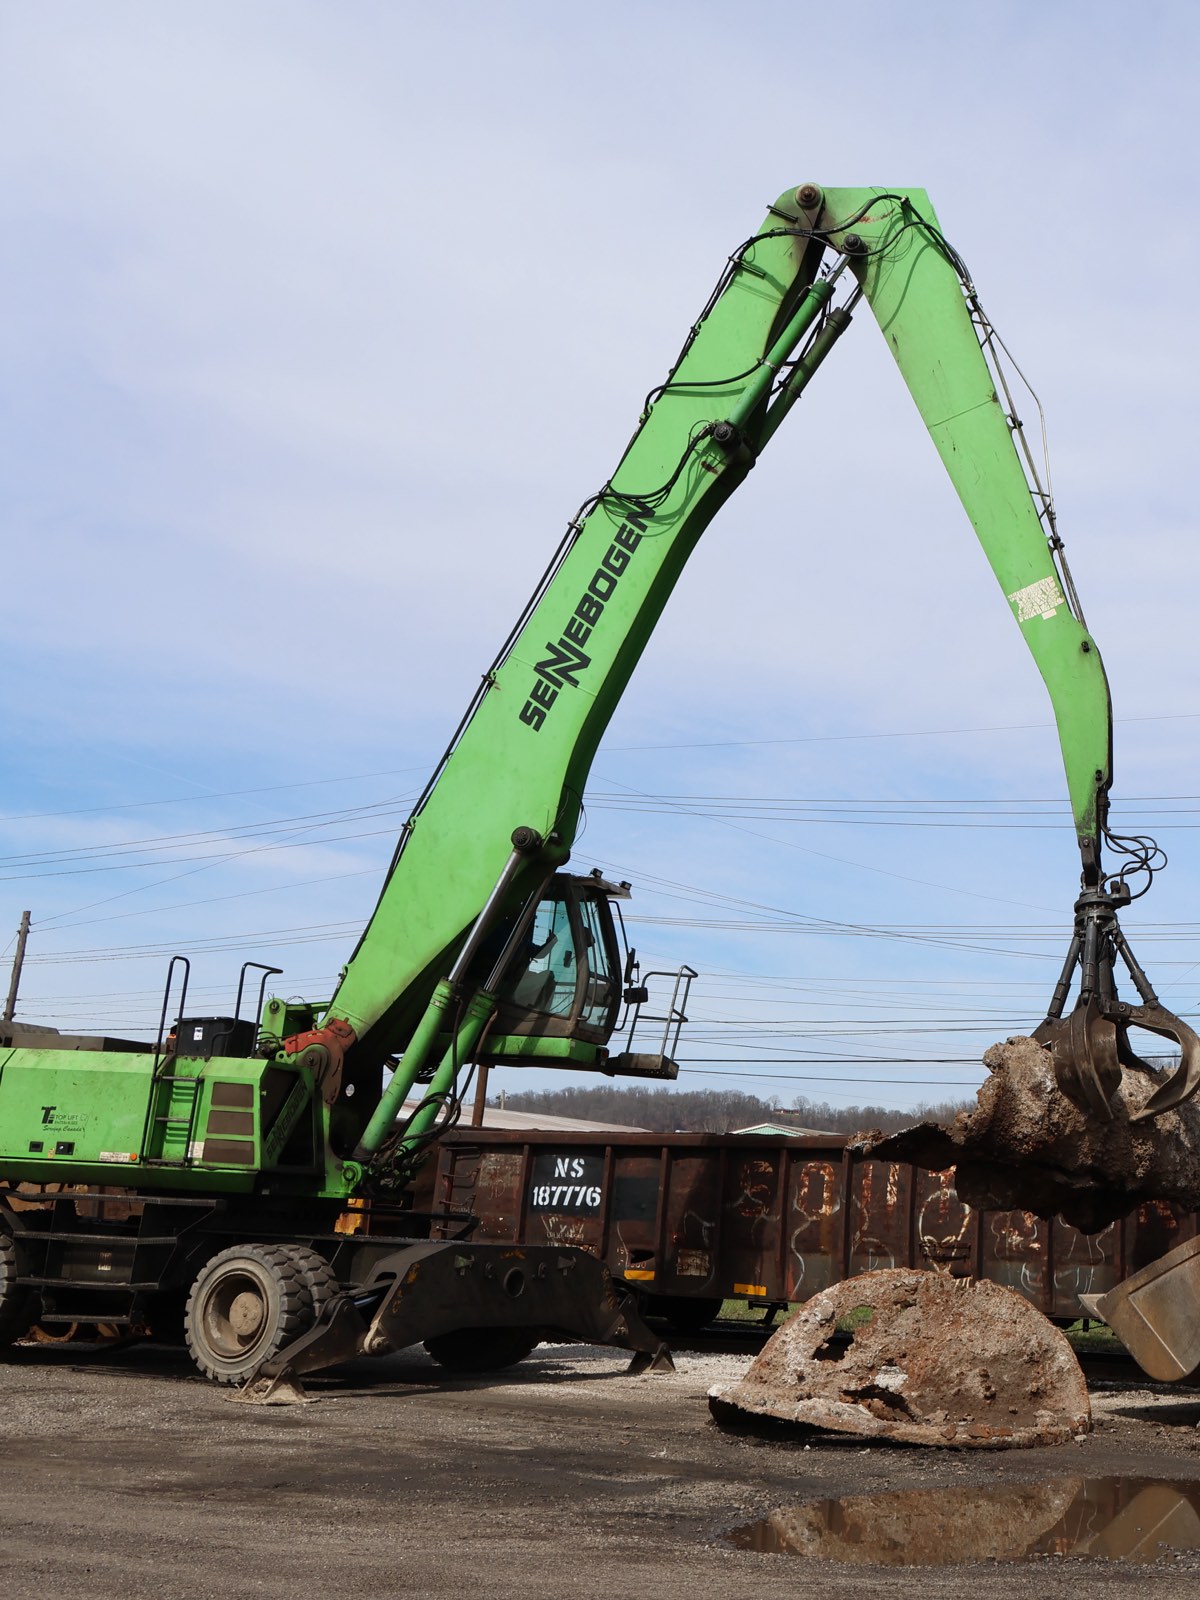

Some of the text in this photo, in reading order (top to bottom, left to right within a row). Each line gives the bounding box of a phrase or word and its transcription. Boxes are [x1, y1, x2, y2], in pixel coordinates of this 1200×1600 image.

[519, 501, 656, 732] SENNEBOGEN
[554, 1157, 585, 1178] NS
[533, 1185, 602, 1207] 187776
